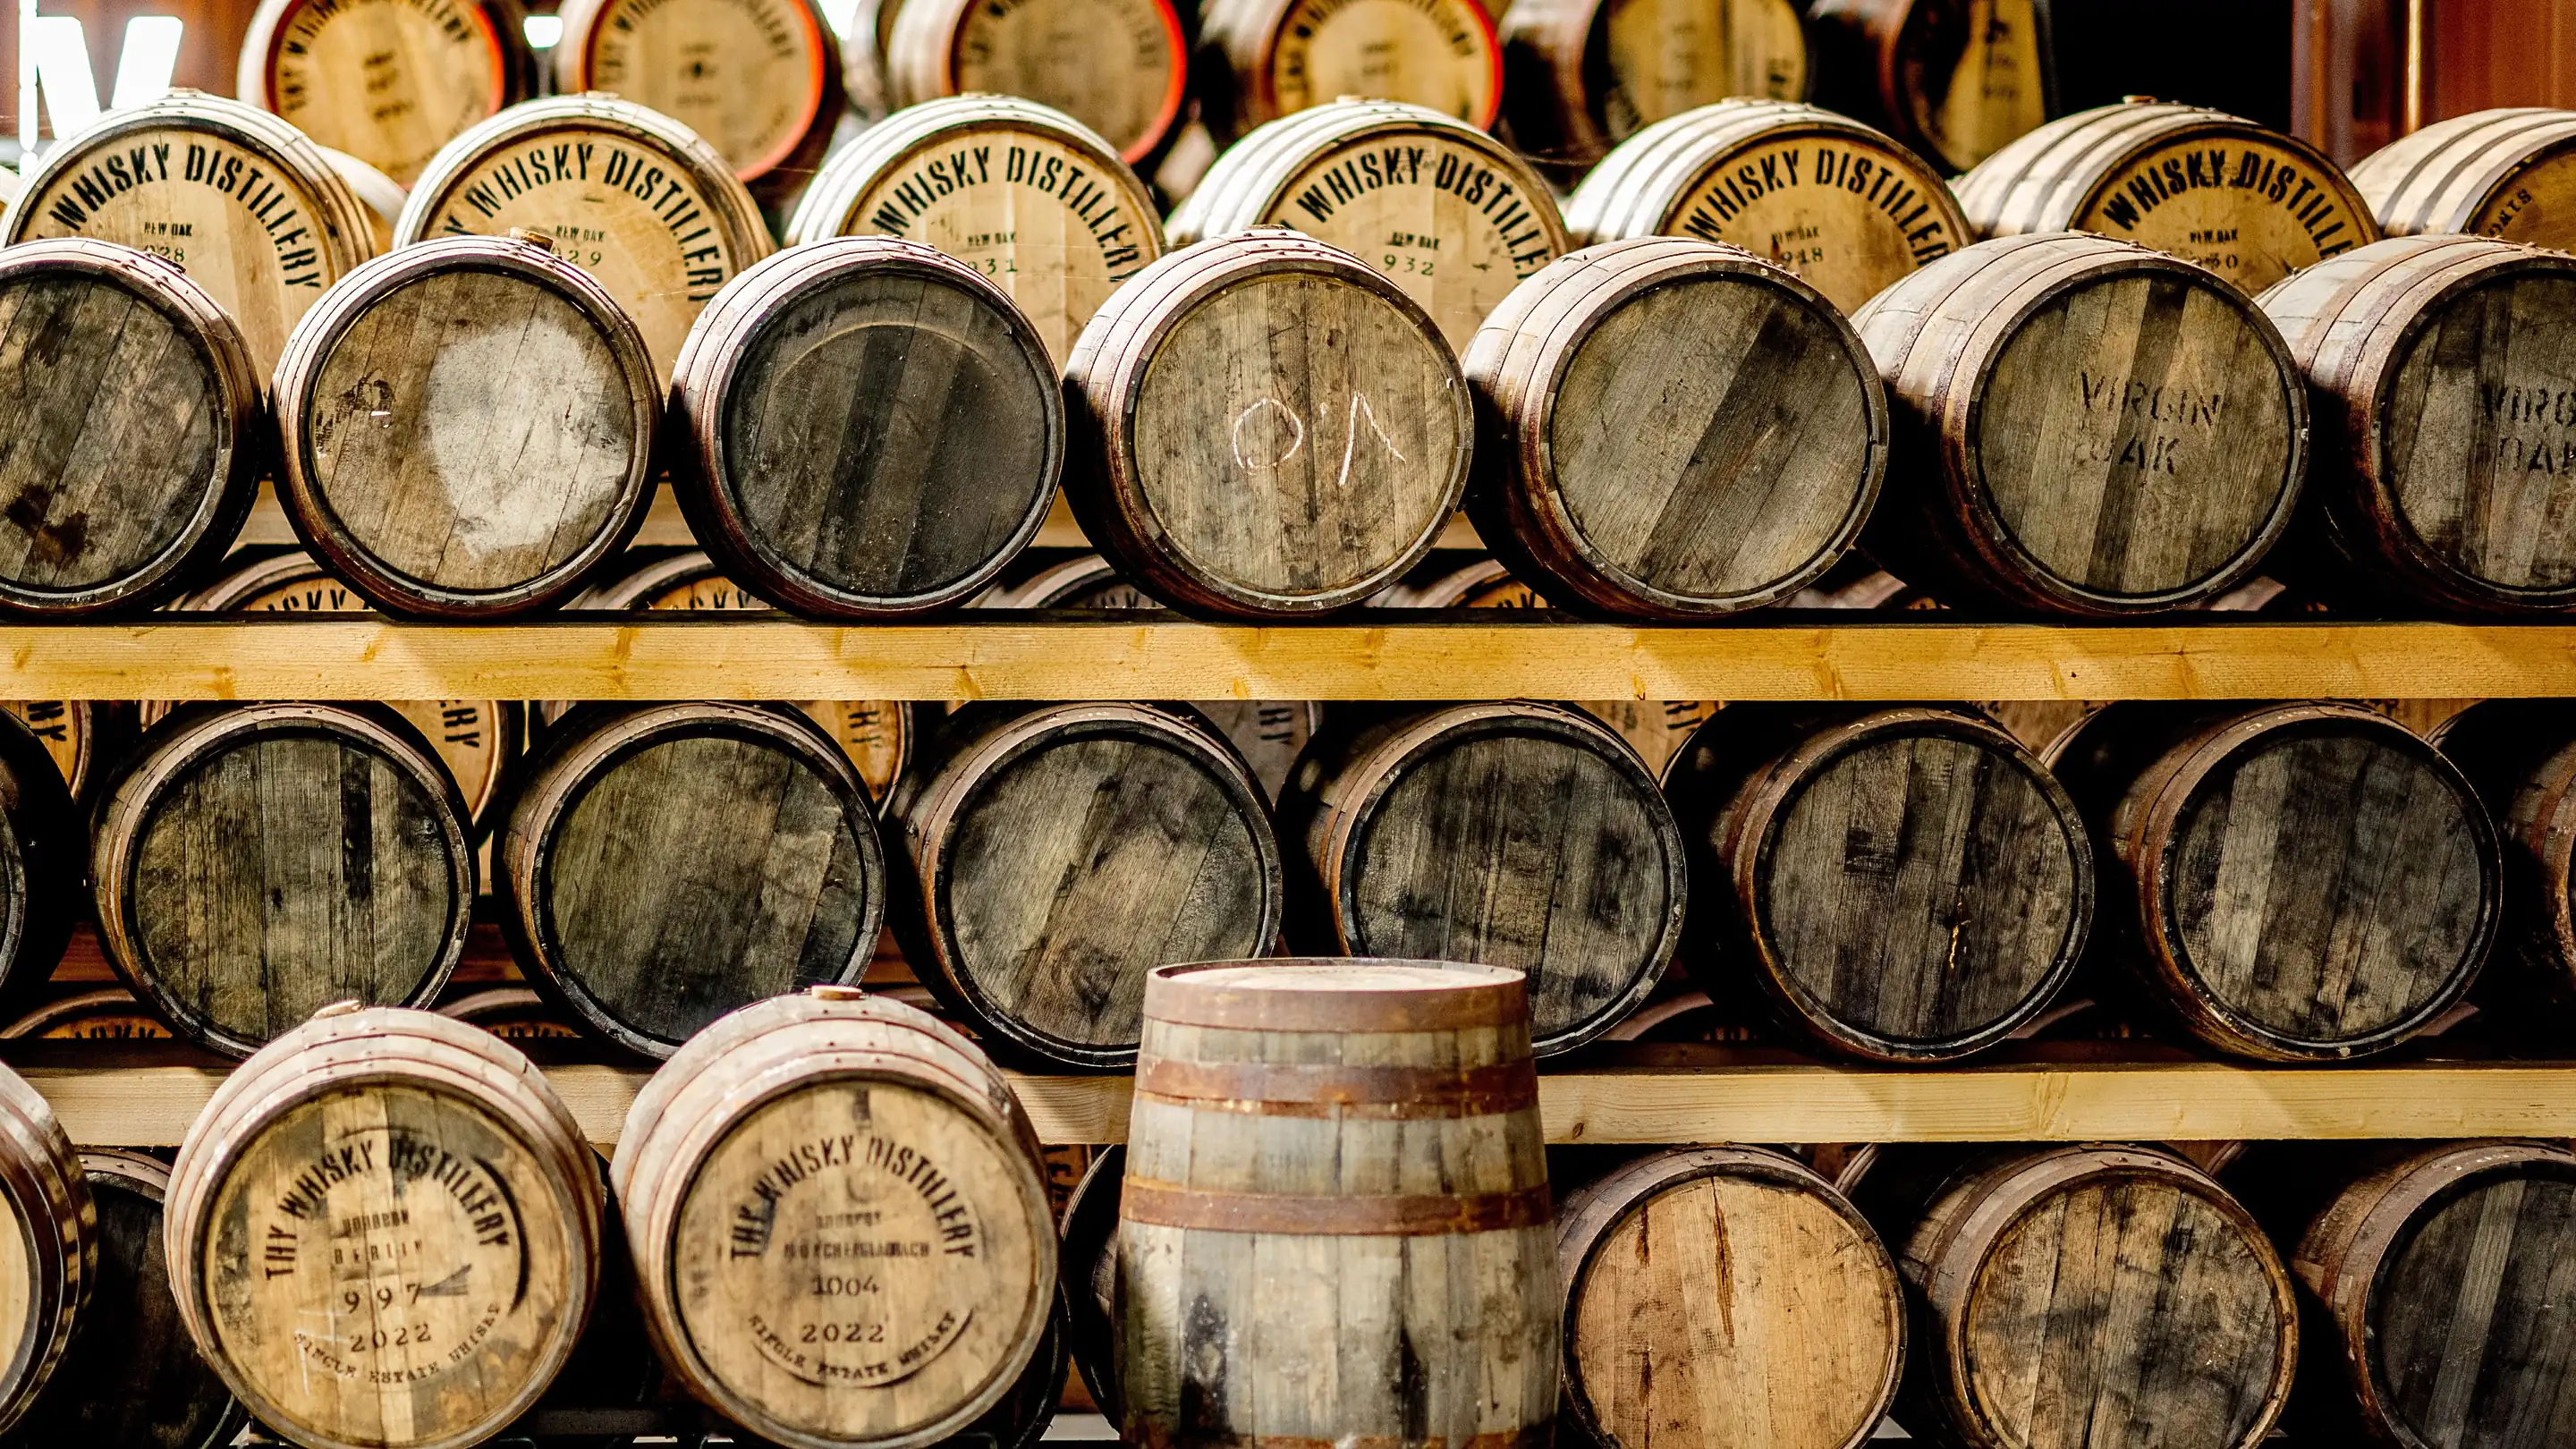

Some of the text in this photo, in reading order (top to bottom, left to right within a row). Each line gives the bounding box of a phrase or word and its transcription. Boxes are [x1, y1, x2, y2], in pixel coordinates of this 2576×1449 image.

[48, 142, 321, 288] WHISKY DISTILLERY
[465, 142, 595, 218] WHISKY
[871, 145, 990, 238] WHISKY
[1296, 147, 1551, 281] WHISKY DISTILLE
[1684, 148, 1800, 242] WHISKY
[2102, 149, 2225, 233] WHISKY
[144, 221, 192, 237] NEW OAK
[555, 225, 606, 243] NEW OAK
[1384, 254, 1435, 276] 932
[2080, 371, 2220, 427] VIRGIN
[265, 1134, 510, 1281] THY WHISKY DISTILLERY
[752, 1134, 855, 1204] WHISKY
[865, 1136, 975, 1258] DISTILLERY
[334, 1240, 423, 1265] BERLIN
[811, 1274, 880, 1297] 1004
[343, 1281, 422, 1314] 997
[801, 1322, 886, 1343] 2022
[350, 1322, 433, 1353] 2022
[369, 1360, 442, 1385] ESTATE
[447, 1301, 501, 1363] WHISKY
[817, 1360, 889, 1381] ESTATE
[898, 1310, 956, 1367] WHISKY
